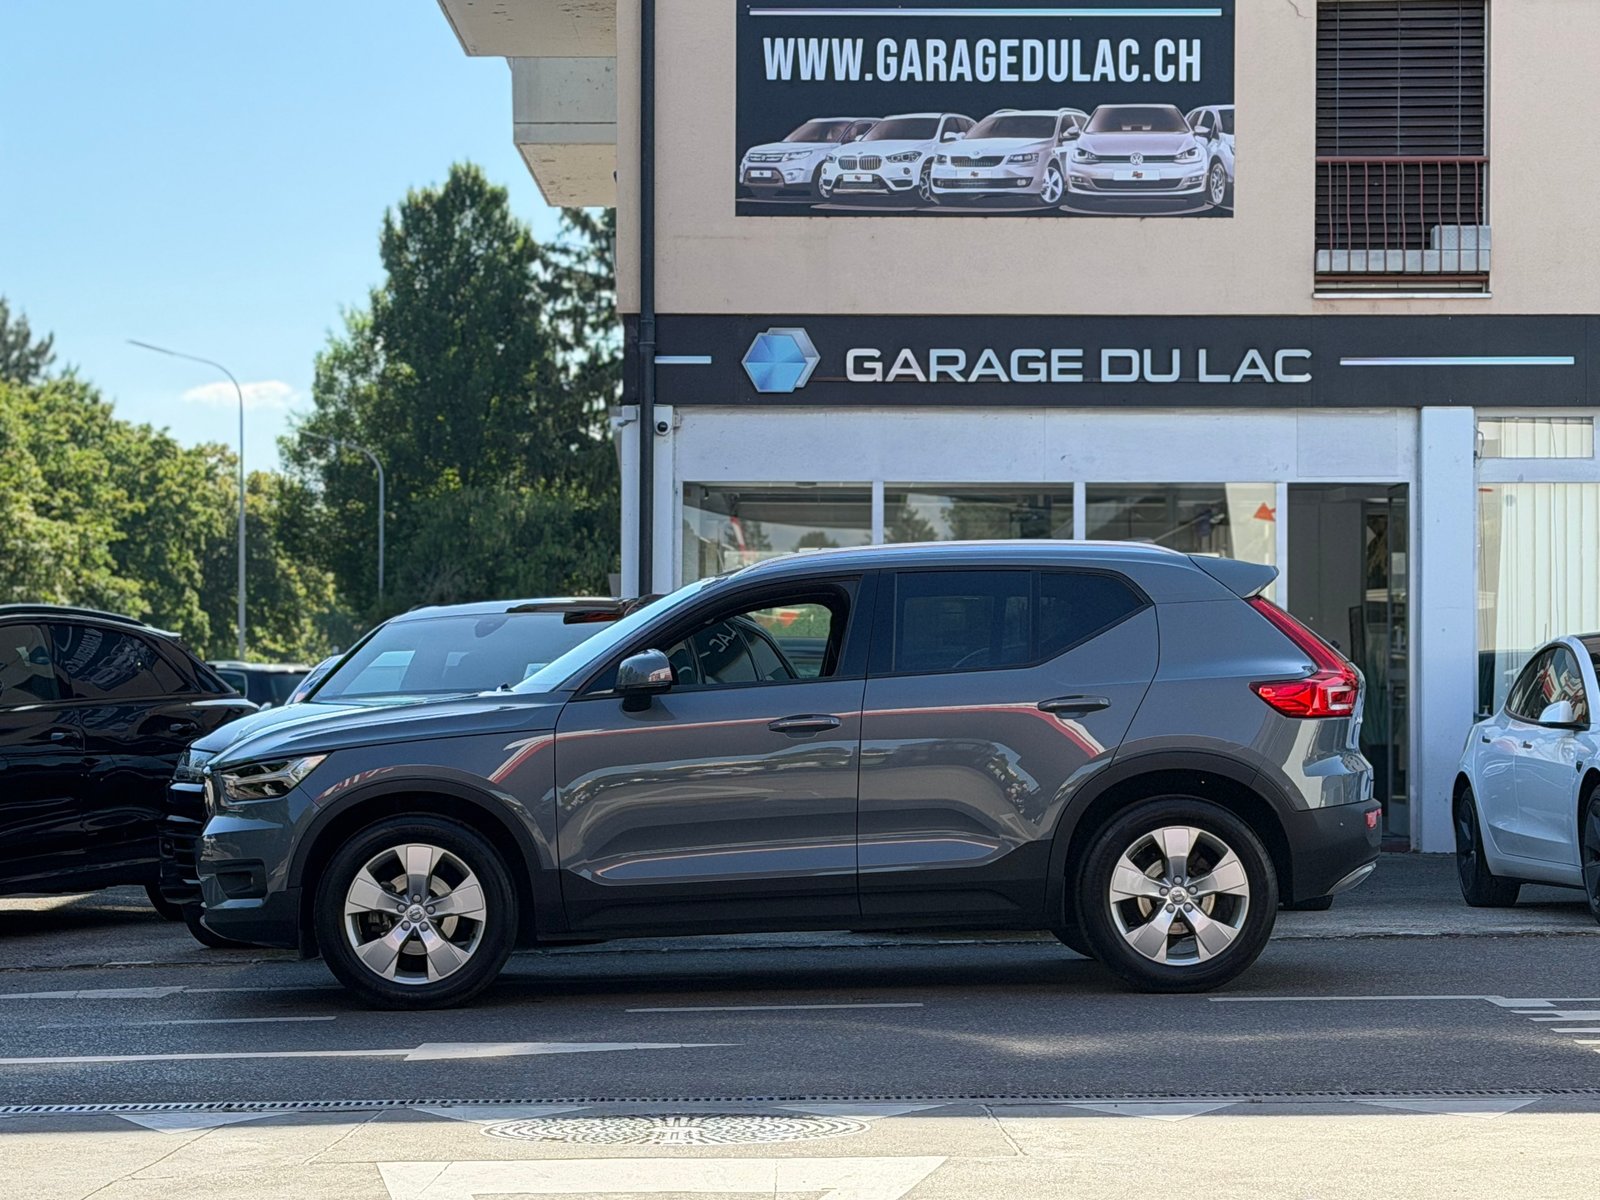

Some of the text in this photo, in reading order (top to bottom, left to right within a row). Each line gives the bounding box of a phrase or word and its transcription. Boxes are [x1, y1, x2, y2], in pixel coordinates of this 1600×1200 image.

[762, 37, 1201, 83] WWW.GARAGEDULAC.CH
[846, 348, 1313, 383] GARAGE DU LAC
